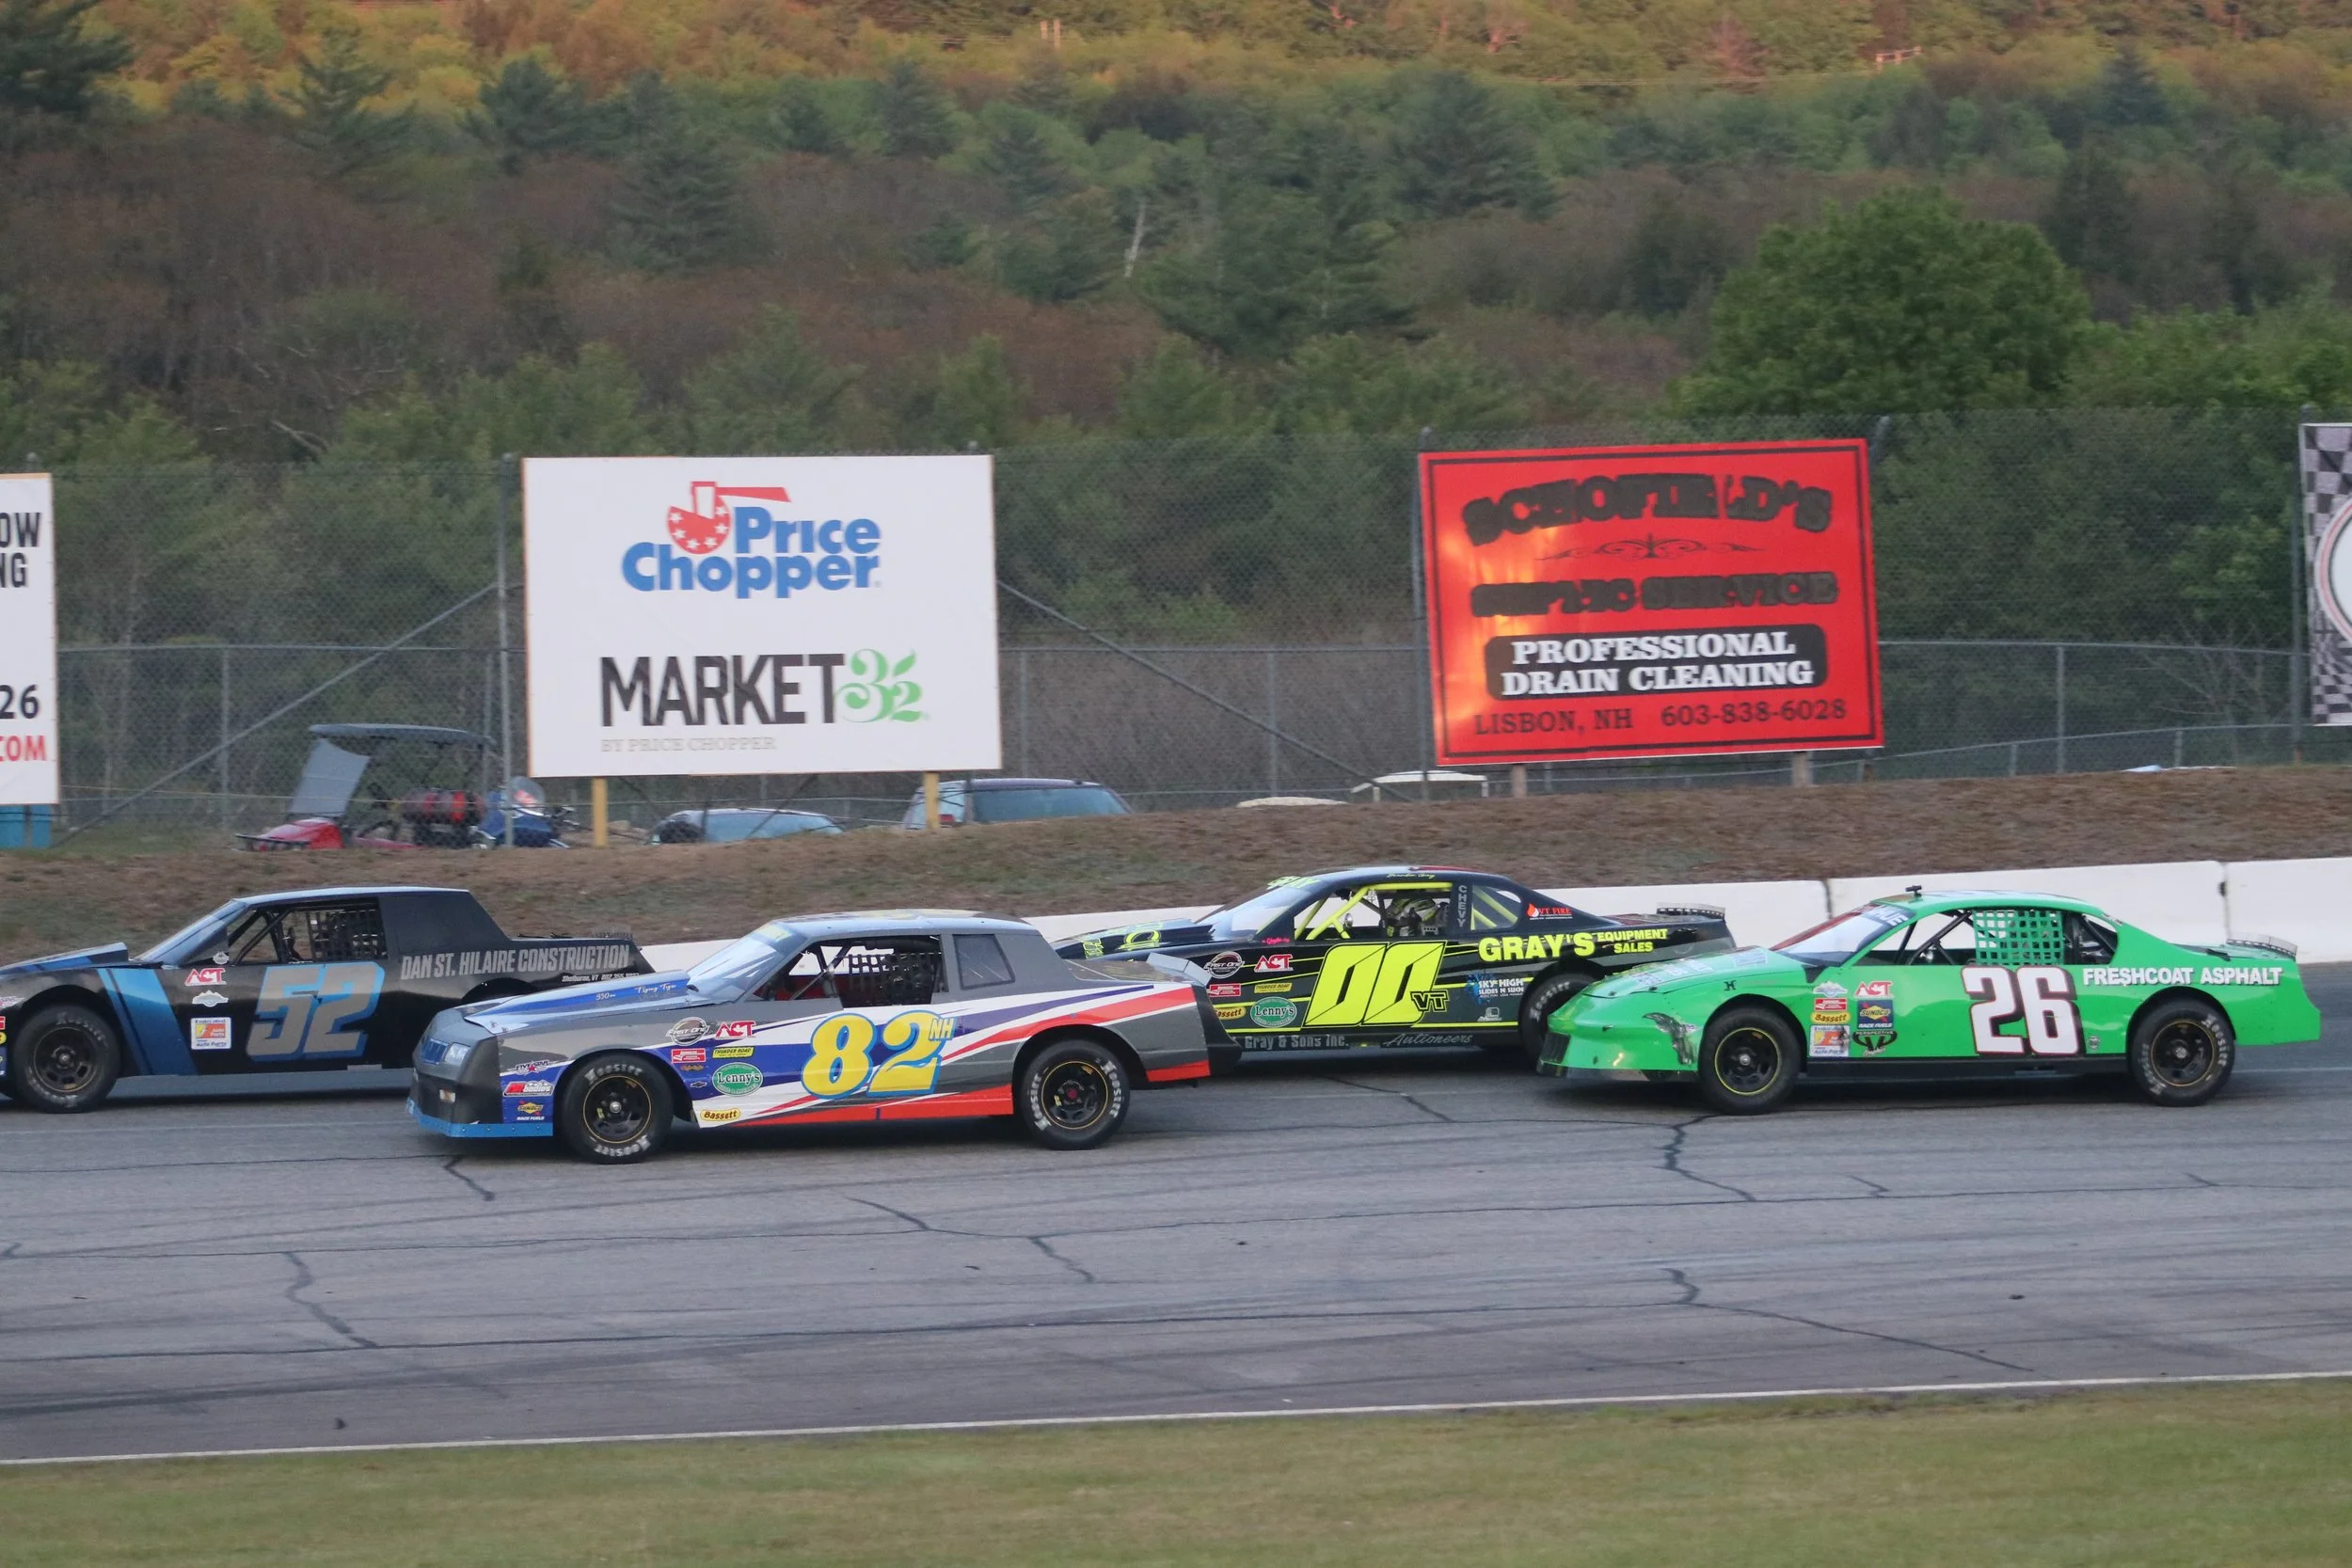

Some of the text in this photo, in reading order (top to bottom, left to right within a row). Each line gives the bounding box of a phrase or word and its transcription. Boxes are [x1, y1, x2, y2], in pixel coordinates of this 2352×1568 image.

[733, 507, 882, 553] Price
[621, 542, 881, 599] Chopper
[1512, 631, 1796, 665] PROFESSIONAL
[599, 648, 924, 727] MARKET 32
[1502, 660, 1814, 697] DRAIN CLEANING
[1474, 699, 1847, 736] LISBON, NH 603-838-6028
[600, 736, 776, 752] BY PRICE CHOPPER
[1457, 884, 1468, 928] CHEVY
[1478, 928, 1669, 962] GRAY'S EQUIPMENT
[1613, 942, 1654, 954] SALES
[401, 944, 629, 981] DAN ST. HILAIRE CONSTRUCTION
[1253, 954, 1294, 971] ACT
[186, 967, 227, 985] ACT
[1303, 941, 1448, 1027] 00
[1478, 977, 1524, 989] SKY HIGH
[2082, 967, 2282, 987] FRESHCOAT ASPHALT
[1854, 981, 1893, 997] ACT
[246, 960, 386, 1062] 52
[1255, 1005, 1295, 1018] Lenny's
[1410, 990, 1449, 1012] VT
[1961, 965, 2083, 1055] 26
[929, 1017, 957, 1041] NH
[1814, 1013, 1847, 1022] Bassett
[715, 1021, 756, 1038] ACT
[801, 1010, 945, 1099] 82
[1244, 1036, 1274, 1051] Gray
[1278, 1036, 1288, 1048] &
[1291, 1035, 1322, 1048] Sons
[717, 1071, 760, 1086] Lenny's
[704, 1110, 738, 1119] Bassett
